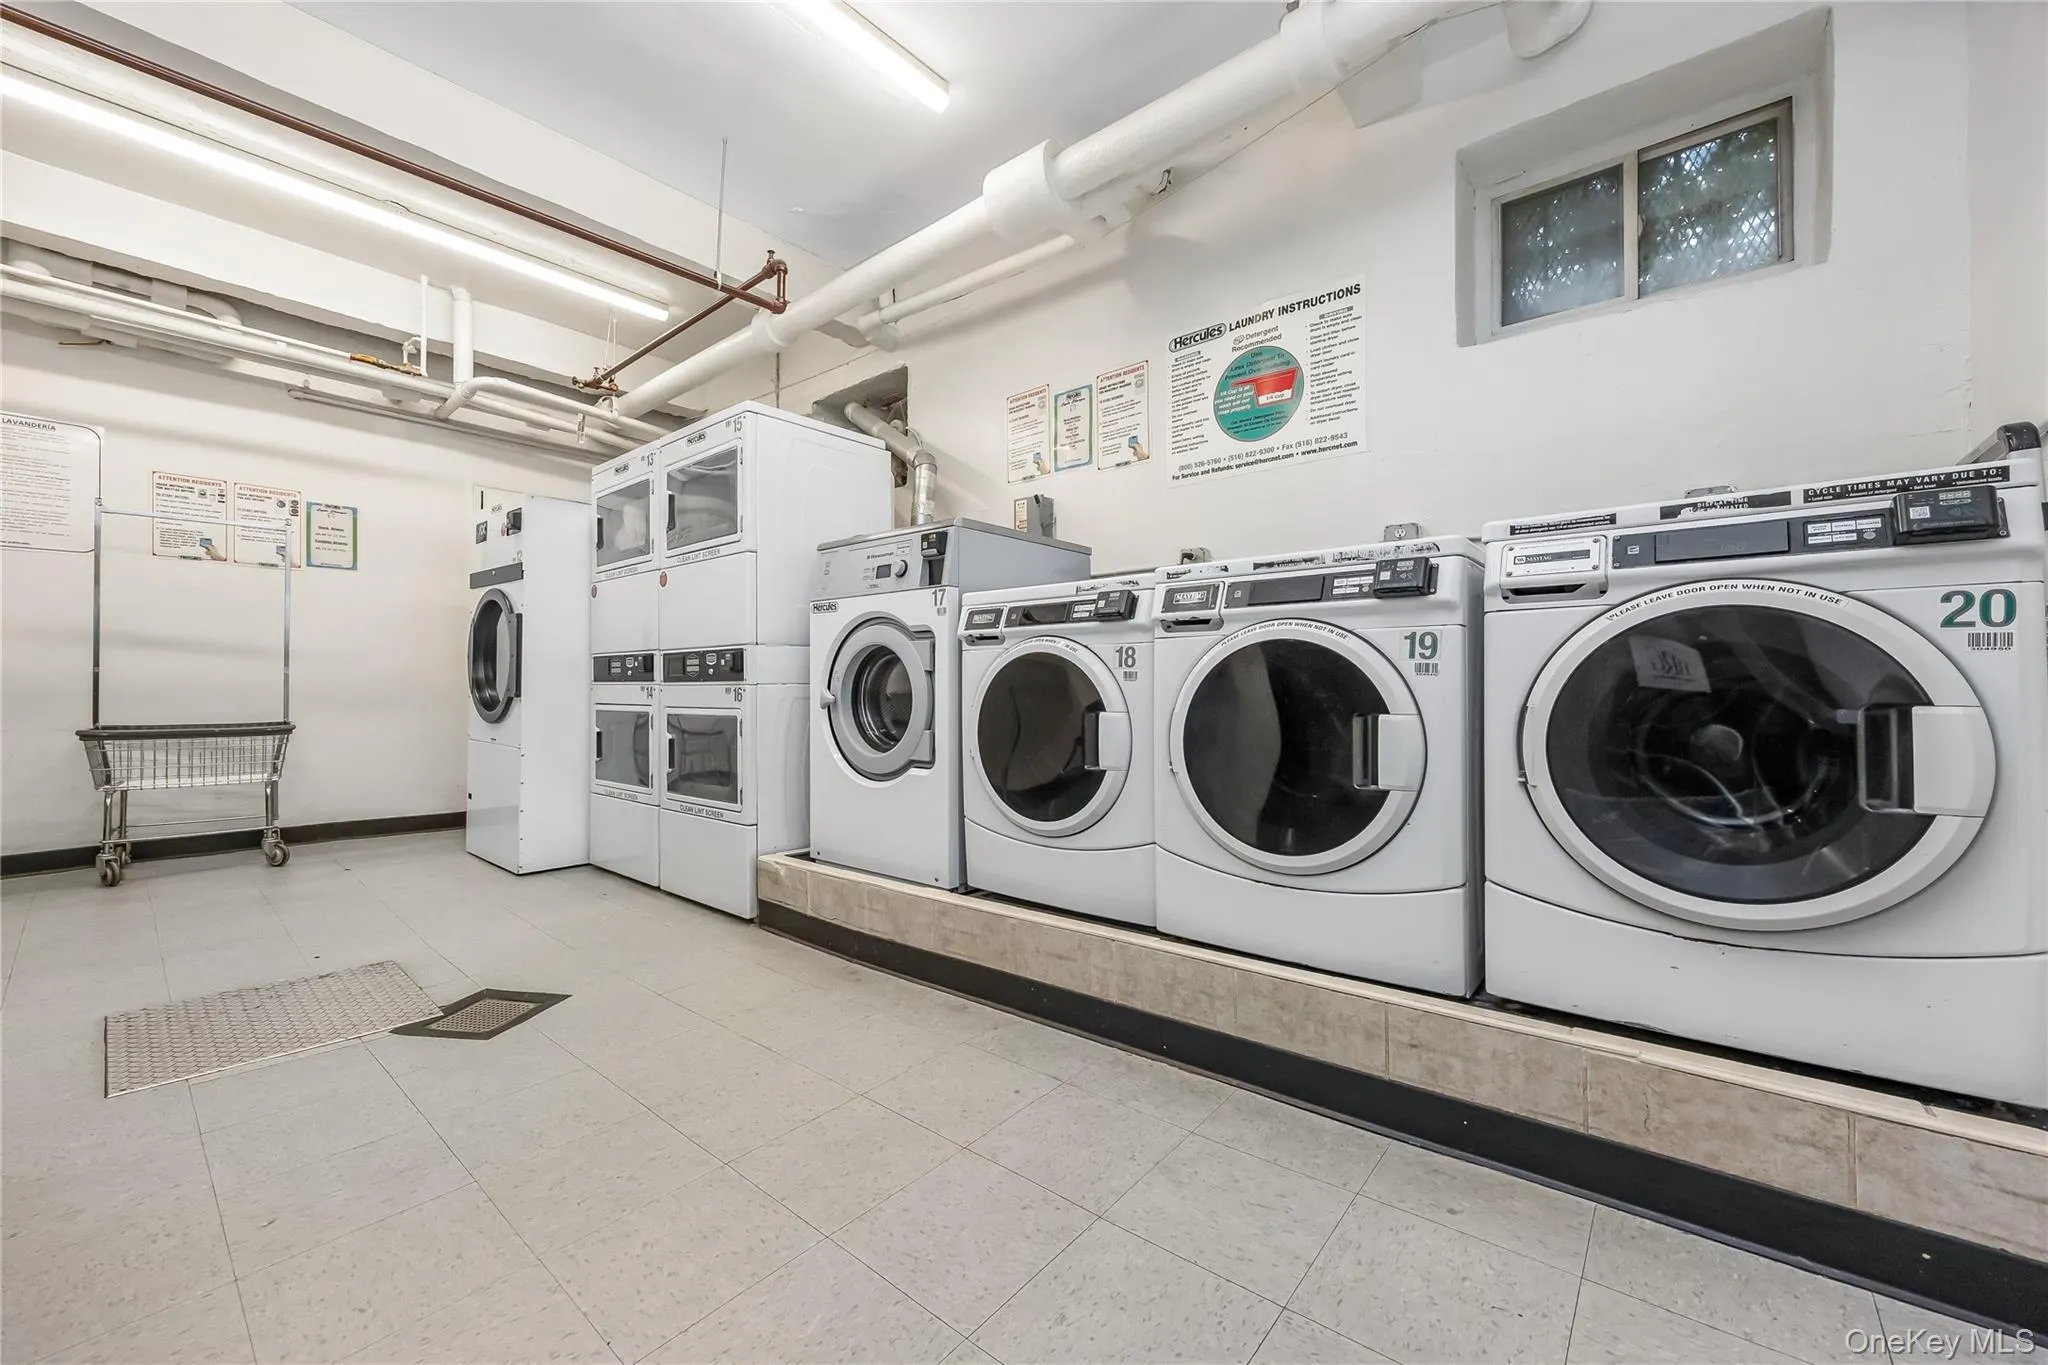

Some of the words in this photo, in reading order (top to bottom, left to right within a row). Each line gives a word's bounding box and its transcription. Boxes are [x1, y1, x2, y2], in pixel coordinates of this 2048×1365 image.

[1174, 326, 1223, 350] Hercules
[1229, 308, 1275, 332] LAUNDRY
[1278, 283, 1361, 316] INSTRUCTIONS
[1245, 325, 1279, 341] Detergent
[1231, 333, 1282, 353] Recommended
[2, 417, 57, 431] LAVANDERÍA
[732, 416, 743, 432] 15
[1281, 443, 1294, 451] Fax
[646, 452, 654, 467] 13
[1181, 470, 1200, 479] Service
[1200, 468, 1210, 476] and
[1300, 440, 1358, 456] www.hercnet.com
[158, 475, 191, 483] ATTENTION
[1808, 486, 1841, 496] CYCLE
[1847, 481, 1881, 491] TIMES
[1886, 478, 1909, 487] MAY
[1915, 474, 1946, 484] VARY
[1952, 470, 1976, 480] DUE
[1982, 468, 2002, 476] TO:
[676, 555, 692, 563] CLEAN
[702, 549, 721, 558] SCREEN
[931, 588, 947, 607] 17
[1607, 603, 1642, 620] PLEASE
[1643, 592, 1673, 606] LEAVE
[1676, 586, 1706, 596] DOOR
[1741, 583, 1776, 591] WHEN
[1778, 586, 1802, 594] NOT
[1804, 590, 1817, 598] IN
[1819, 594, 1843, 605] USE
[812, 602, 837, 612] Hercules
[1939, 588, 2017, 629] 20
[1221, 633, 1240, 646] PLEASE
[1240, 626, 1257, 637] LEAVE
[1258, 622, 1276, 630] DOOR
[1294, 621, 1313, 629] WHEN
[1313, 624, 1327, 632] NOT
[1335, 630, 1349, 640] USE
[1403, 631, 1439, 660] 19
[1115, 646, 1137, 668] 18
[733, 686, 743, 702] 16
[680, 804, 694, 813] CLEAN
[694, 806, 705, 815] LINT
[705, 808, 724, 818] SCREEN
